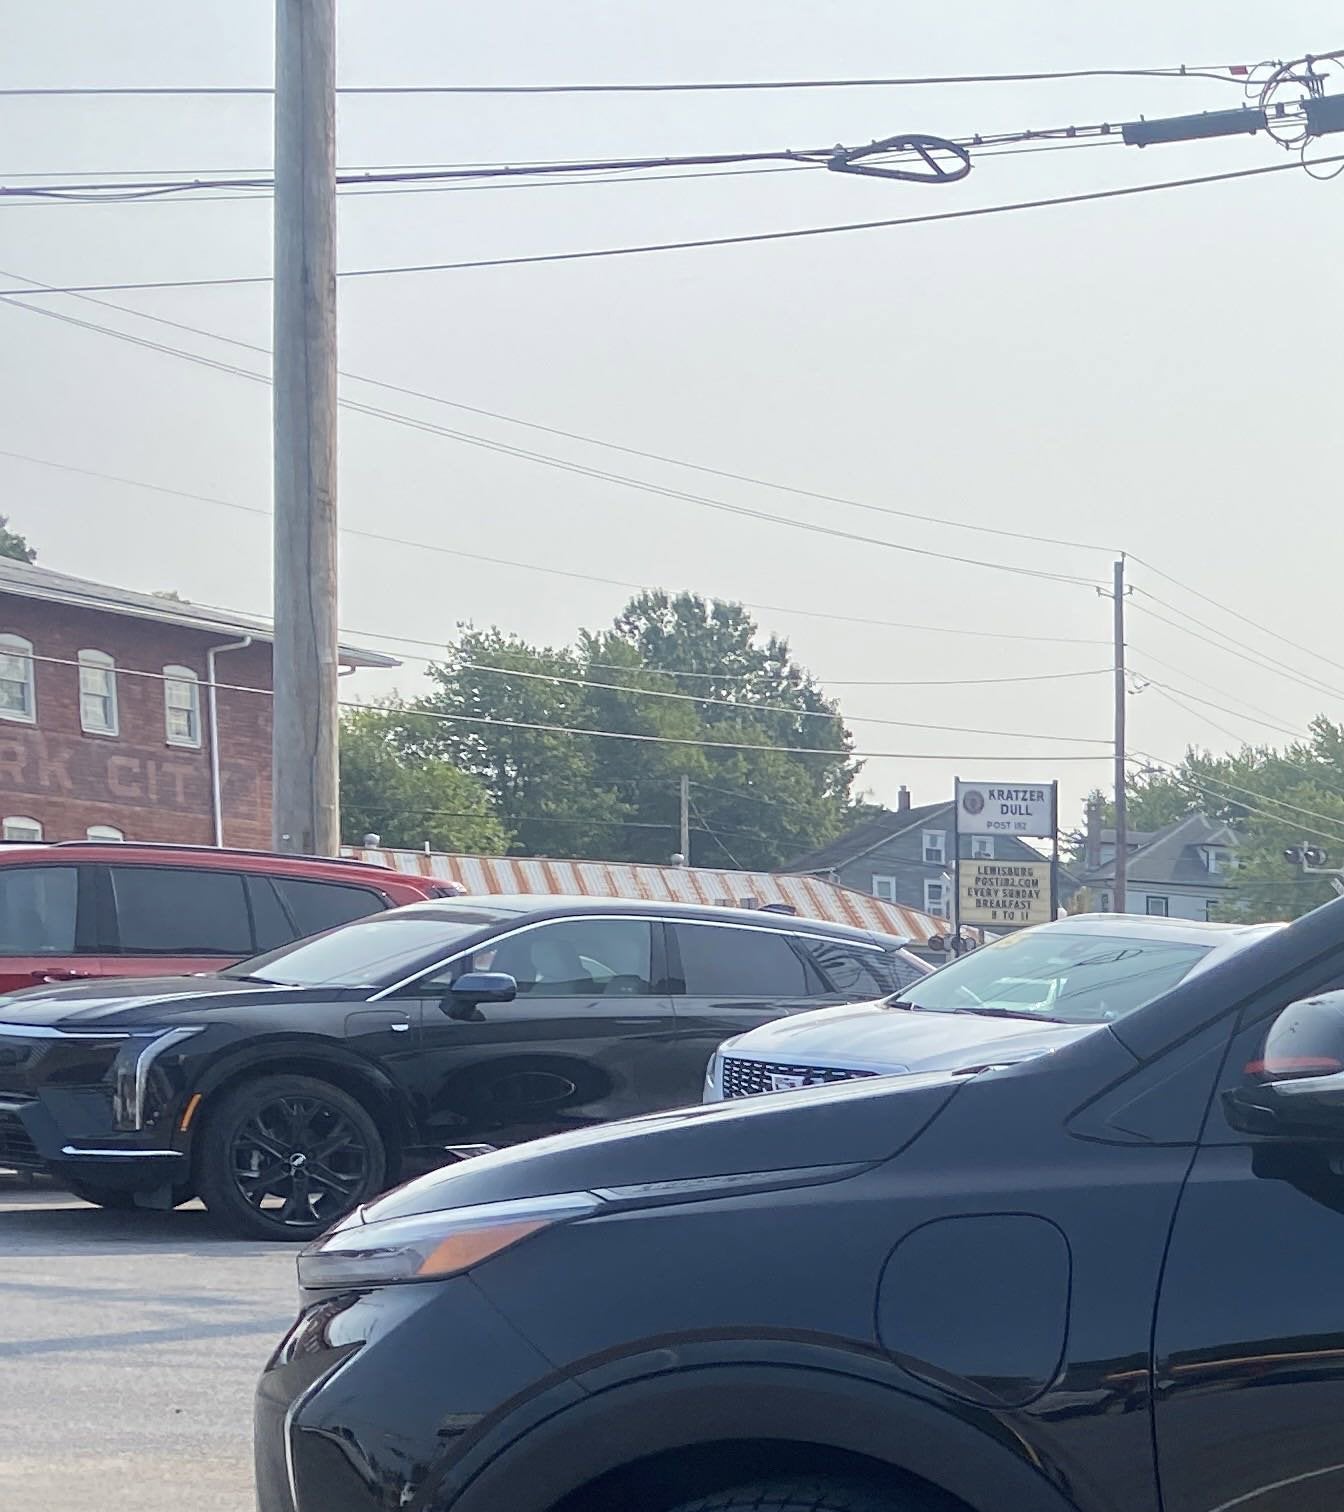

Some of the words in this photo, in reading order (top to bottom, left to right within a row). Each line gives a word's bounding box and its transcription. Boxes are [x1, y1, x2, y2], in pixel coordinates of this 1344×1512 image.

[988, 789, 1045, 802] KRATZER
[1000, 803, 1032, 816] DULL
[986, 820, 1011, 830] POST
[977, 865, 1034, 877] LEWISBURG
[967, 887, 999, 898] EVERY
[1002, 888, 1040, 899] SUNDAY
[975, 898, 1032, 909] BREAKFAST
[1003, 910, 1015, 920] TO
